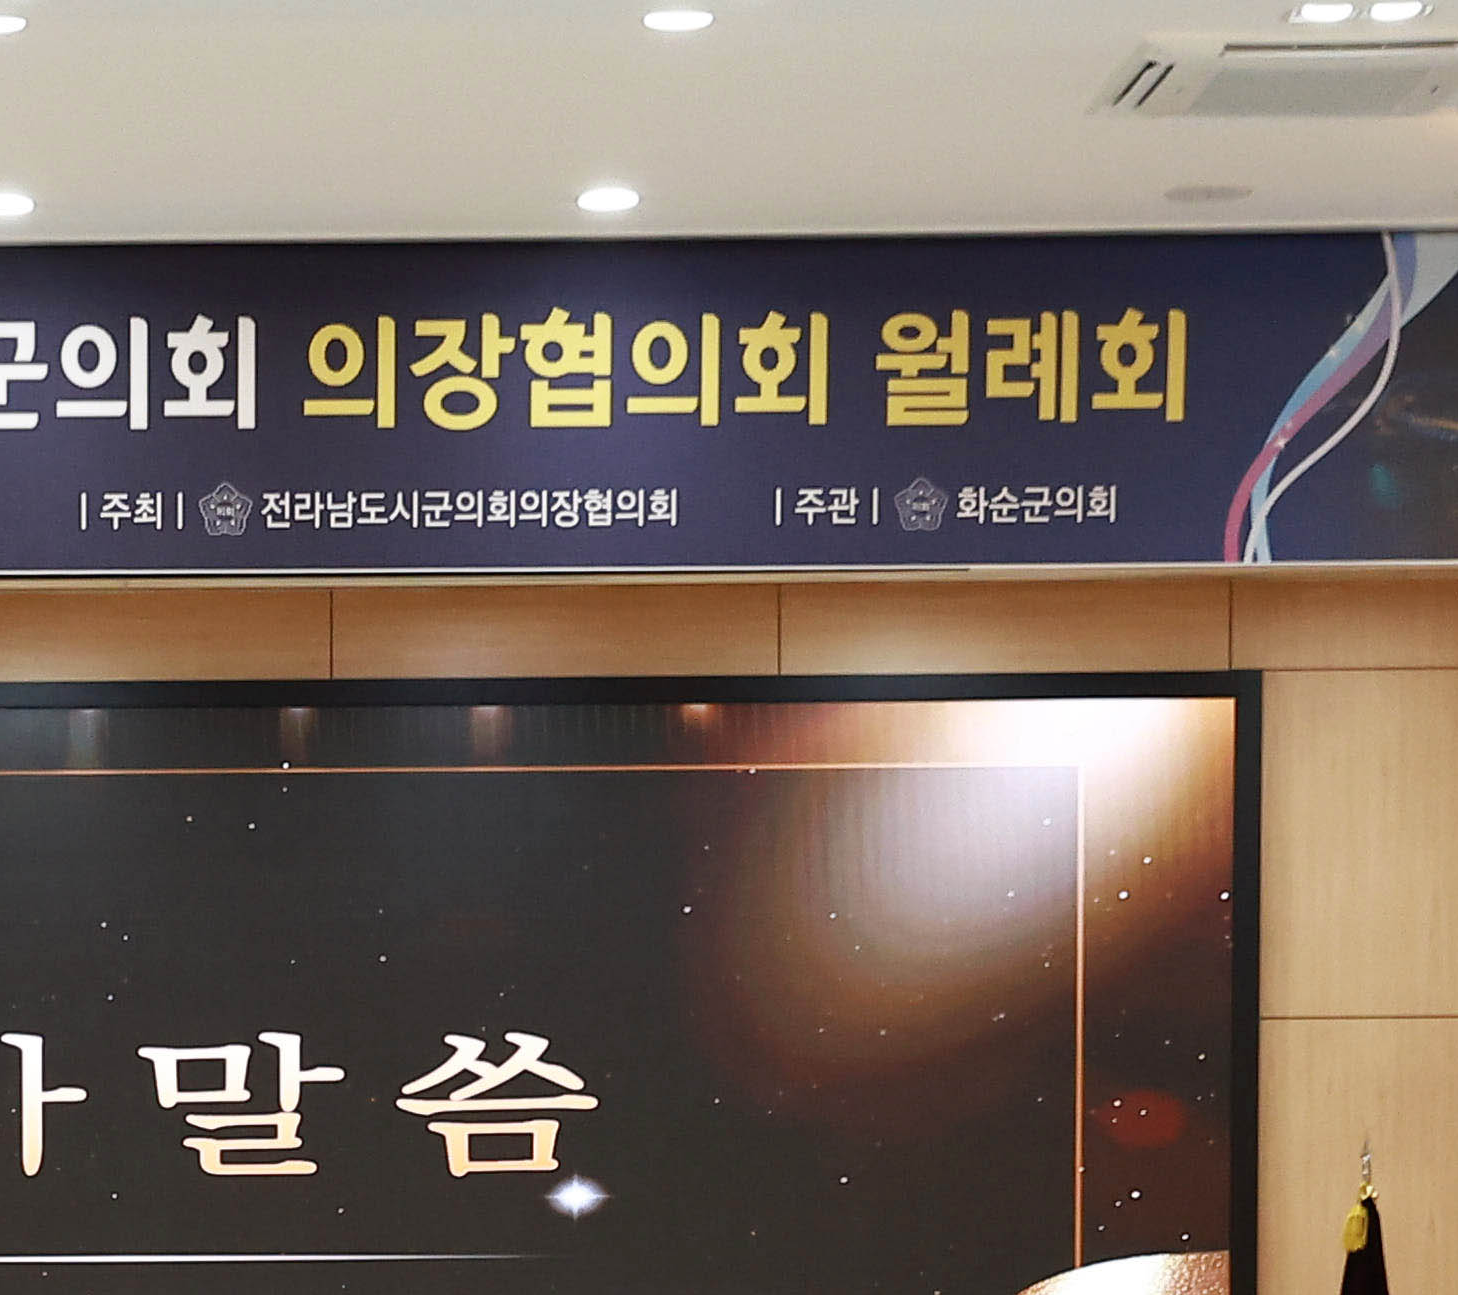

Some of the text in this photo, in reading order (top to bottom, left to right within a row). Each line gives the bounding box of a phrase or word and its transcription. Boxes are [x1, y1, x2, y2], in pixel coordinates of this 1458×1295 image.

[303, 307, 828, 431] 의장협의회
[876, 307, 1185, 426] 월례회
[99, 491, 163, 530] 주최
[261, 488, 678, 529] 전라남도시군의회의장협의회
[794, 484, 1117, 525] 주관 화순군의회
